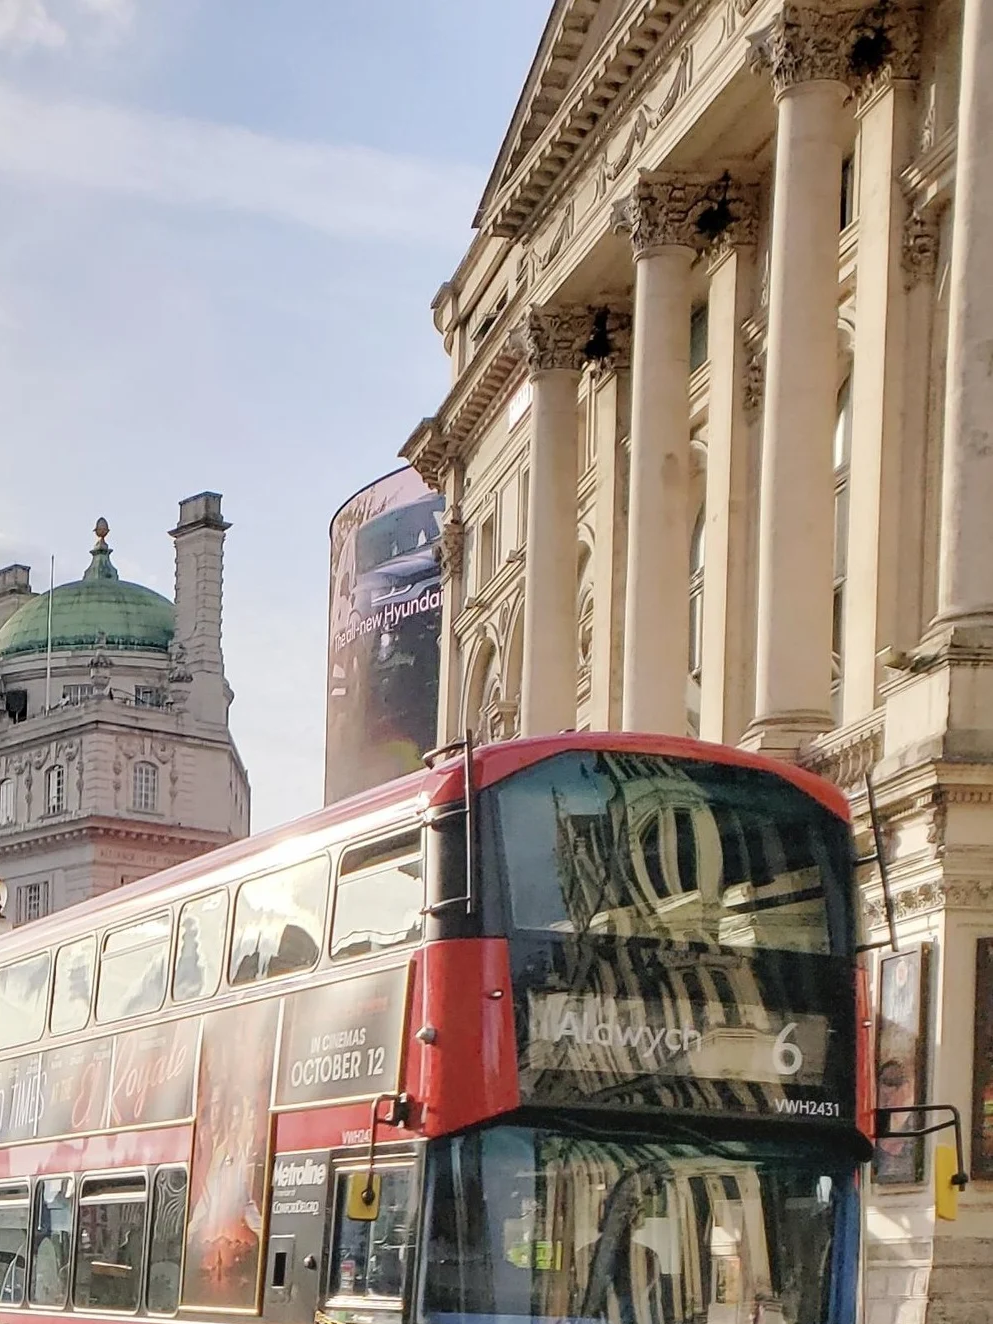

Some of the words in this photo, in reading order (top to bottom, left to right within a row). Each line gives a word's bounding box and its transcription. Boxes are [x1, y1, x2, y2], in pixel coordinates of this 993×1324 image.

[335, 633, 346, 653] The
[346, 611, 383, 644] all-new
[384, 585, 444, 625] Hyundai
[310, 1036, 321, 1053] IN
[322, 1027, 367, 1051] CINEMAS
[555, 1011, 702, 1058] Aldwych
[772, 1022, 803, 1075] 6
[291, 1050, 361, 1087] OCTOBER
[367, 1046, 385, 1076] 12
[8, 1071, 48, 1130] TIMES
[775, 1098, 840, 1118] VWH2431
[274, 1159, 326, 1187] Metroline
